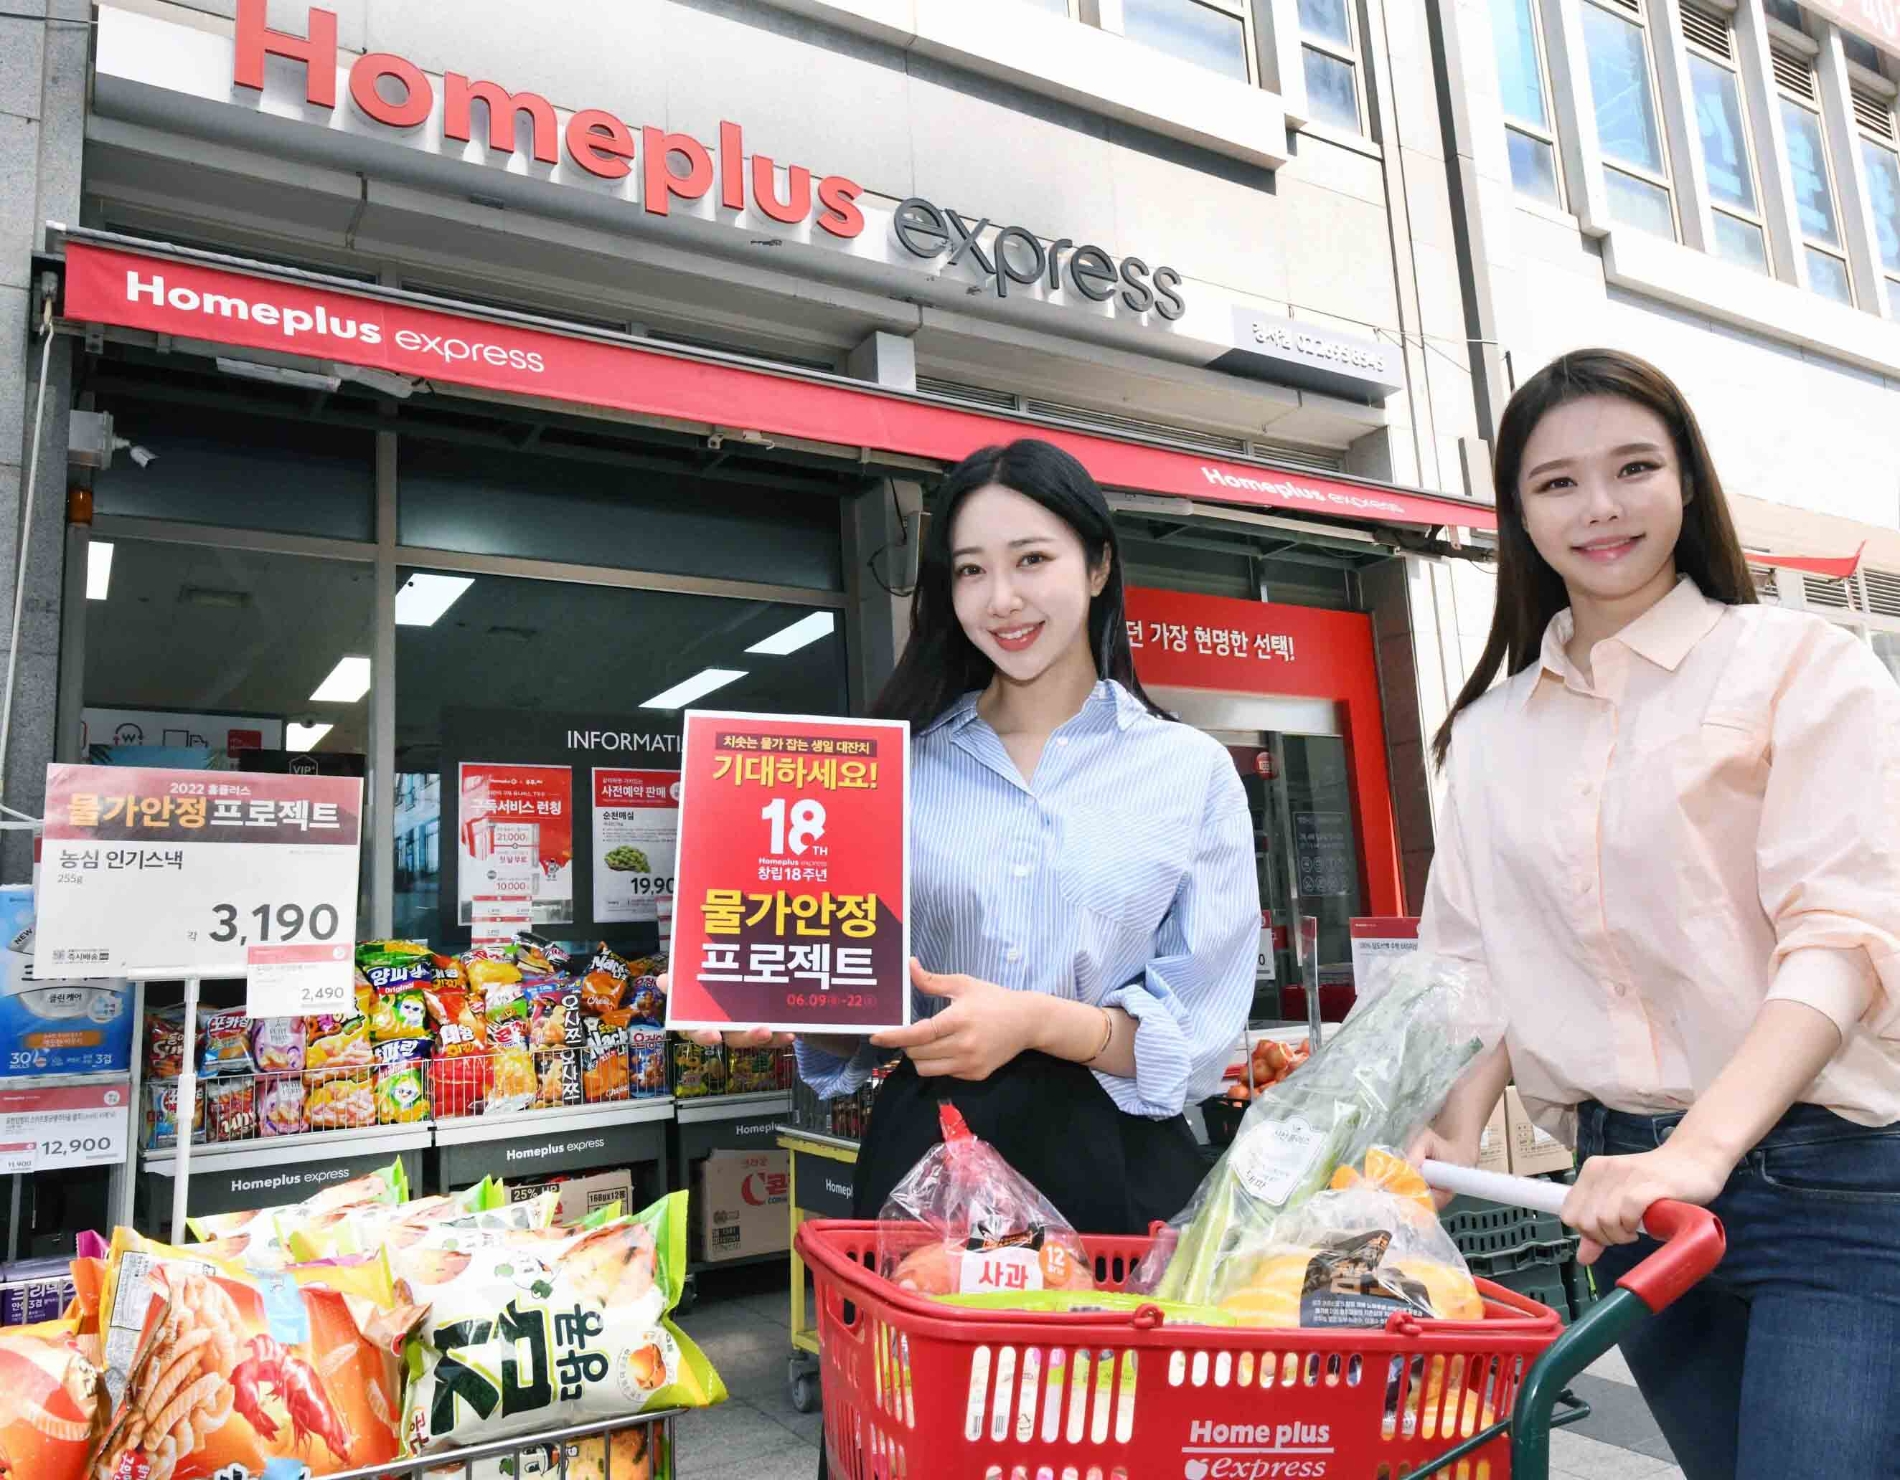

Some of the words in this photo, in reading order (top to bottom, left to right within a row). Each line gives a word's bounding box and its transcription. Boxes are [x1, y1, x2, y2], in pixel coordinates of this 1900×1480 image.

[234, 0, 864, 238] Homeplus
[894, 197, 1185, 320] express
[126, 270, 381, 344] Homeplus
[395, 327, 545, 372] express
[1201, 467, 1326, 501] Homeplus
[1151, 623, 1188, 652] 가장
[1194, 626, 1248, 657] 현명한
[1253, 634, 1295, 661] 선택!
[723, 735, 758, 748] 치솟는
[761, 737, 784, 749] 물가
[786, 738, 809, 751] 잡는
[811, 740, 834, 752] 생일
[836, 741, 870, 754] 대잔치
[713, 754, 878, 790] 기대하세요!
[170, 783, 204, 795] 2022
[602, 785, 644, 798] 사전예약
[645, 786, 666, 798] 판매
[69, 792, 207, 829] 물가안정
[210, 799, 341, 832] 프로젝트
[537, 800, 562, 816] 런칭
[603, 811, 634, 821] 순천매실
[761, 798, 826, 856] 18
[812, 846, 828, 856] TH
[59, 849, 99, 869] 농심
[106, 850, 183, 870] 인기스낵
[758, 857, 799, 866] Homeplus
[57, 874, 83, 885] 255g
[700, 889, 877, 937] 물가안정
[209, 903, 340, 946] 3,190
[14, 928, 33, 945] NEW
[697, 943, 877, 990] 프로젝트
[302, 987, 344, 1002] 2,490
[385, 982, 415, 993] Original
[10, 1051, 30, 1065] 30
[736, 1122, 781, 1135] Homeplu
[41, 1137, 111, 1156] 12,900
[506, 1144, 564, 1161] Homeplus
[567, 1139, 604, 1152] express
[231, 1174, 300, 1191] Homeplus
[304, 1169, 350, 1182] express
[514, 1188, 538, 1201] 25%
[1046, 1245, 1065, 1266] 12
[979, 1261, 1029, 1289] 사과
[556, 1303, 609, 1401] 땅콩
[1190, 1420, 1270, 1443] Home
[1274, 1421, 1330, 1449] plus
[1211, 1457, 1326, 1480] express
